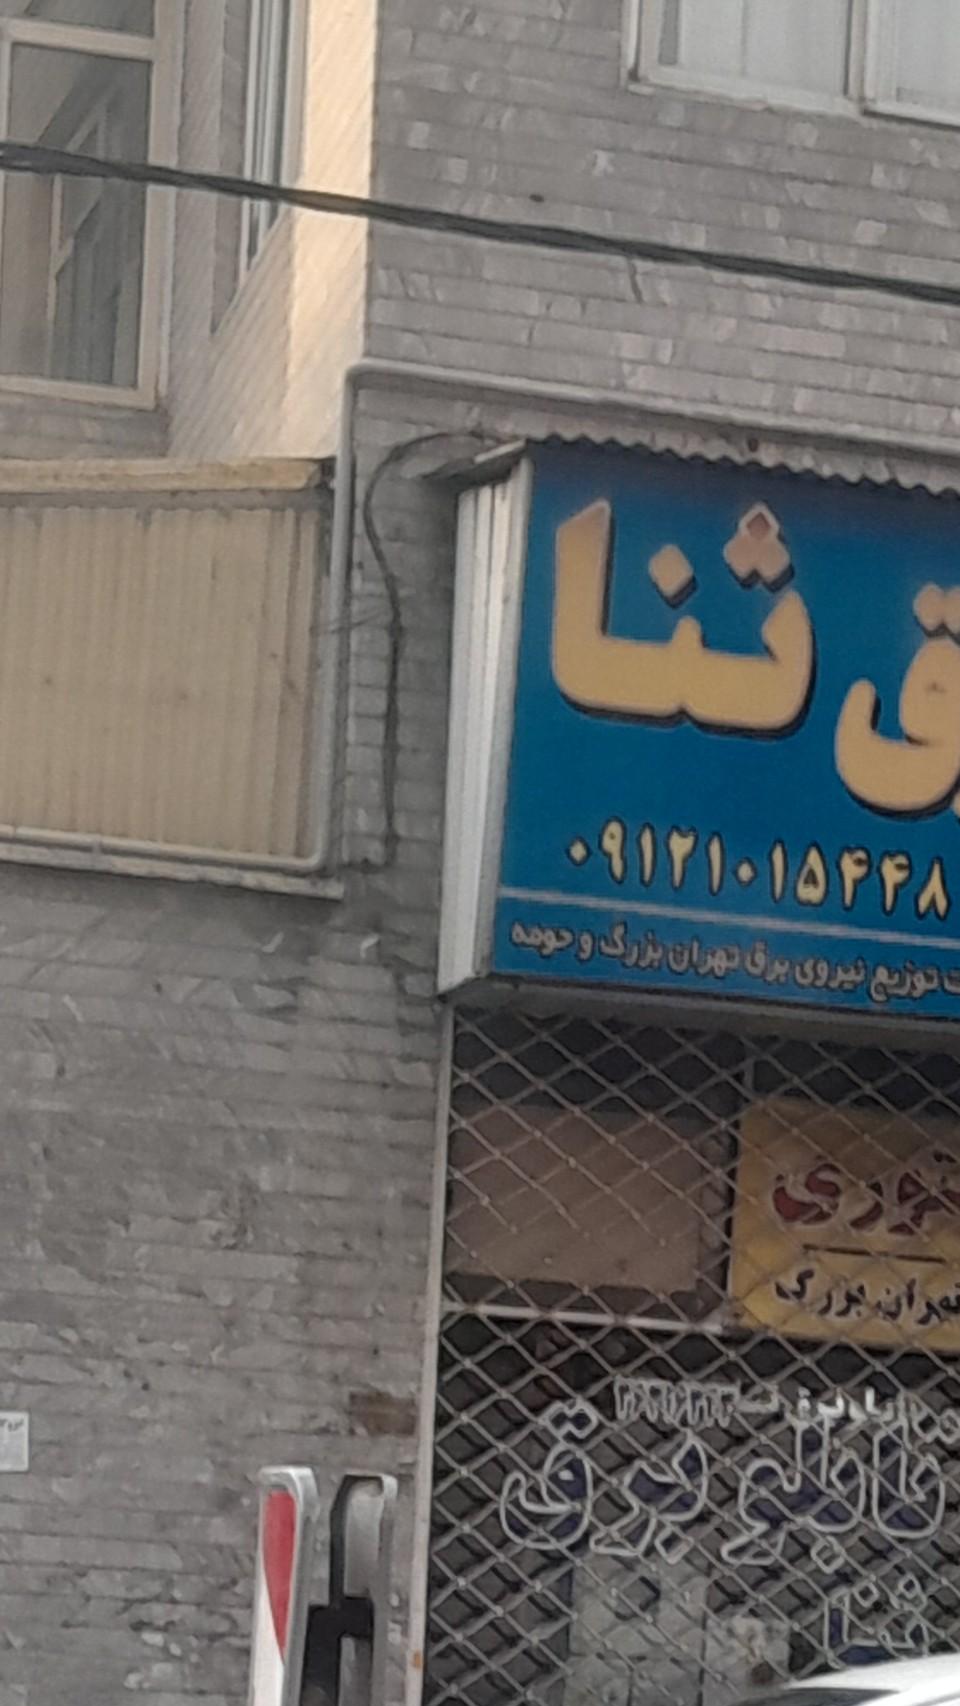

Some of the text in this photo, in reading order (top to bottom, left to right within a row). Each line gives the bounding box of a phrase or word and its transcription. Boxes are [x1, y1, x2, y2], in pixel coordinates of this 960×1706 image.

[551, 497, 816, 736] ثنا
[567, 816, 950, 921] ۰۹۱۲۱۰۱۵۴۴۸
[509, 919, 575, 957] حومه
[576, 929, 594, 963] و
[599, 919, 663, 969] بزرگ
[667, 936, 741, 980] تهران
[743, 938, 791, 984] برق
[793, 956, 867, 990] نیروی
[869, 959, 940, 1003] توزیع
